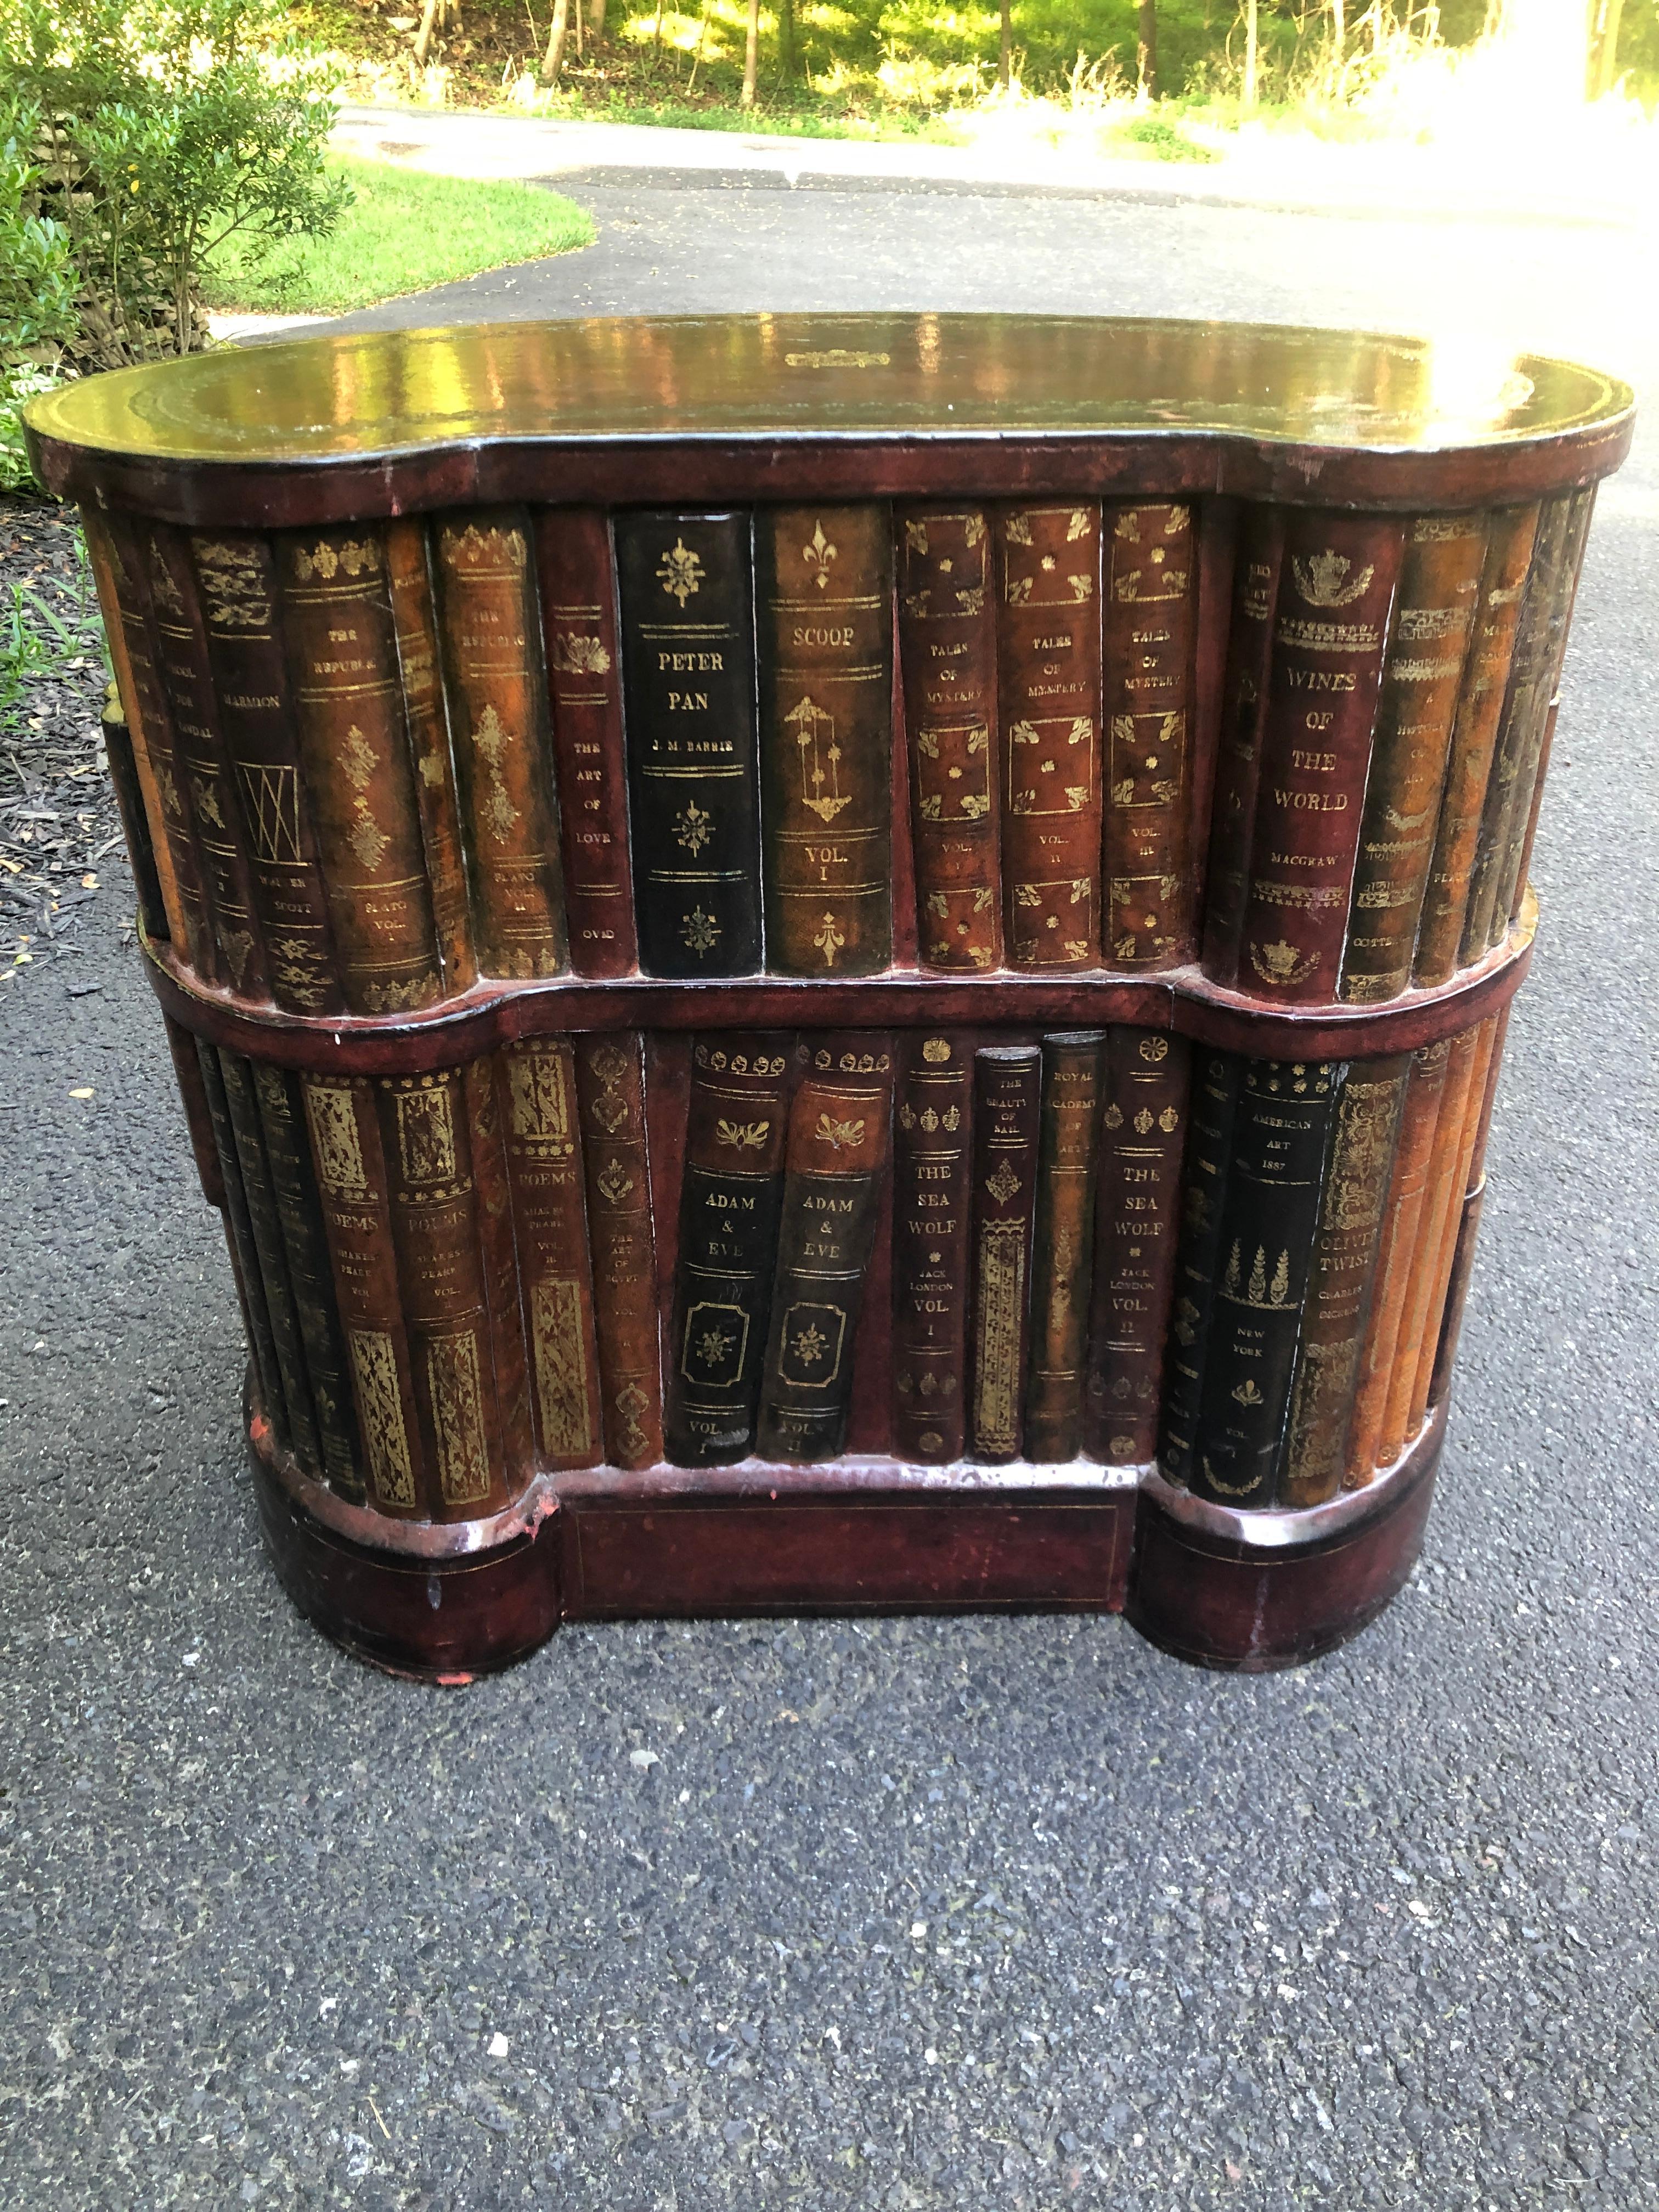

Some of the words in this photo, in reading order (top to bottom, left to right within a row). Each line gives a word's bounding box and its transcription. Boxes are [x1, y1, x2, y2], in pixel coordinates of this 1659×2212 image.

[793, 627, 854, 646] SCOOP
[1032, 635, 1072, 650] TALES
[1132, 629, 1171, 643] TALES
[930, 642, 968, 656] TALES
[658, 652, 724, 671] PETER
[1142, 656, 1160, 668] OF
[940, 669, 957, 681] OF
[1043, 663, 1062, 675] OF
[1125, 675, 1181, 690] MYSTERY
[1286, 667, 1357, 692] WINES
[1028, 681, 1087, 697] MYSTERY
[668, 692, 709, 710] PAN
[1306, 711, 1334, 730] OF
[574, 743, 601, 754] THE
[652, 739, 663, 751] J.
[686, 740, 733, 752] BARRIE
[1291, 749, 1337, 771] THE
[577, 770, 602, 781] ART
[584, 799, 601, 810] OF
[1273, 788, 1348, 811] WORLD
[575, 832, 611, 844] LOVE
[1132, 827, 1161, 838] VOL.
[1039, 834, 1070, 845] VOL.
[941, 843, 973, 853] VOL.
[805, 847, 849, 863] VOL.
[1270, 852, 1339, 867] MACGRAW
[820, 866, 827, 881] I
[583, 929, 614, 939] OVID
[1053, 1071, 1093, 1082] ROYAL
[1000, 1079, 1022, 1089] THE
[986, 1097, 1028, 1108] BEAUTY
[1001, 1112, 1017, 1121] OF
[1251, 1113, 1313, 1130] AMERICAN
[994, 1125, 1021, 1134] SAIL
[1266, 1139, 1291, 1150] ART
[1262, 1159, 1286, 1171] 1887
[518, 1171, 576, 1186] POEMS
[915, 1165, 952, 1180] THE
[1124, 1167, 1161, 1182] THE
[705, 1192, 757, 1210] ADAM
[802, 1195, 855, 1212] ADAM
[918, 1193, 951, 1206] SEA
[1125, 1197, 1159, 1210] SEA
[721, 1220, 734, 1233] &
[820, 1220, 833, 1234] &
[908, 1219, 957, 1234] WOLF
[1114, 1221, 1164, 1235] WOLF
[708, 1242, 743, 1257] EVE
[803, 1242, 840, 1259] EVE
[919, 1269, 947, 1278] JACK
[1121, 1268, 1150, 1278] JACK
[909, 1282, 953, 1291] LONDON
[1109, 1280, 1155, 1290] LONDON
[913, 1299, 950, 1312] VOL.
[1112, 1297, 1149, 1311] VOL.
[927, 1324, 934, 1336] I
[1237, 1327, 1265, 1339] NEW
[1233, 1344, 1263, 1358] YORK
